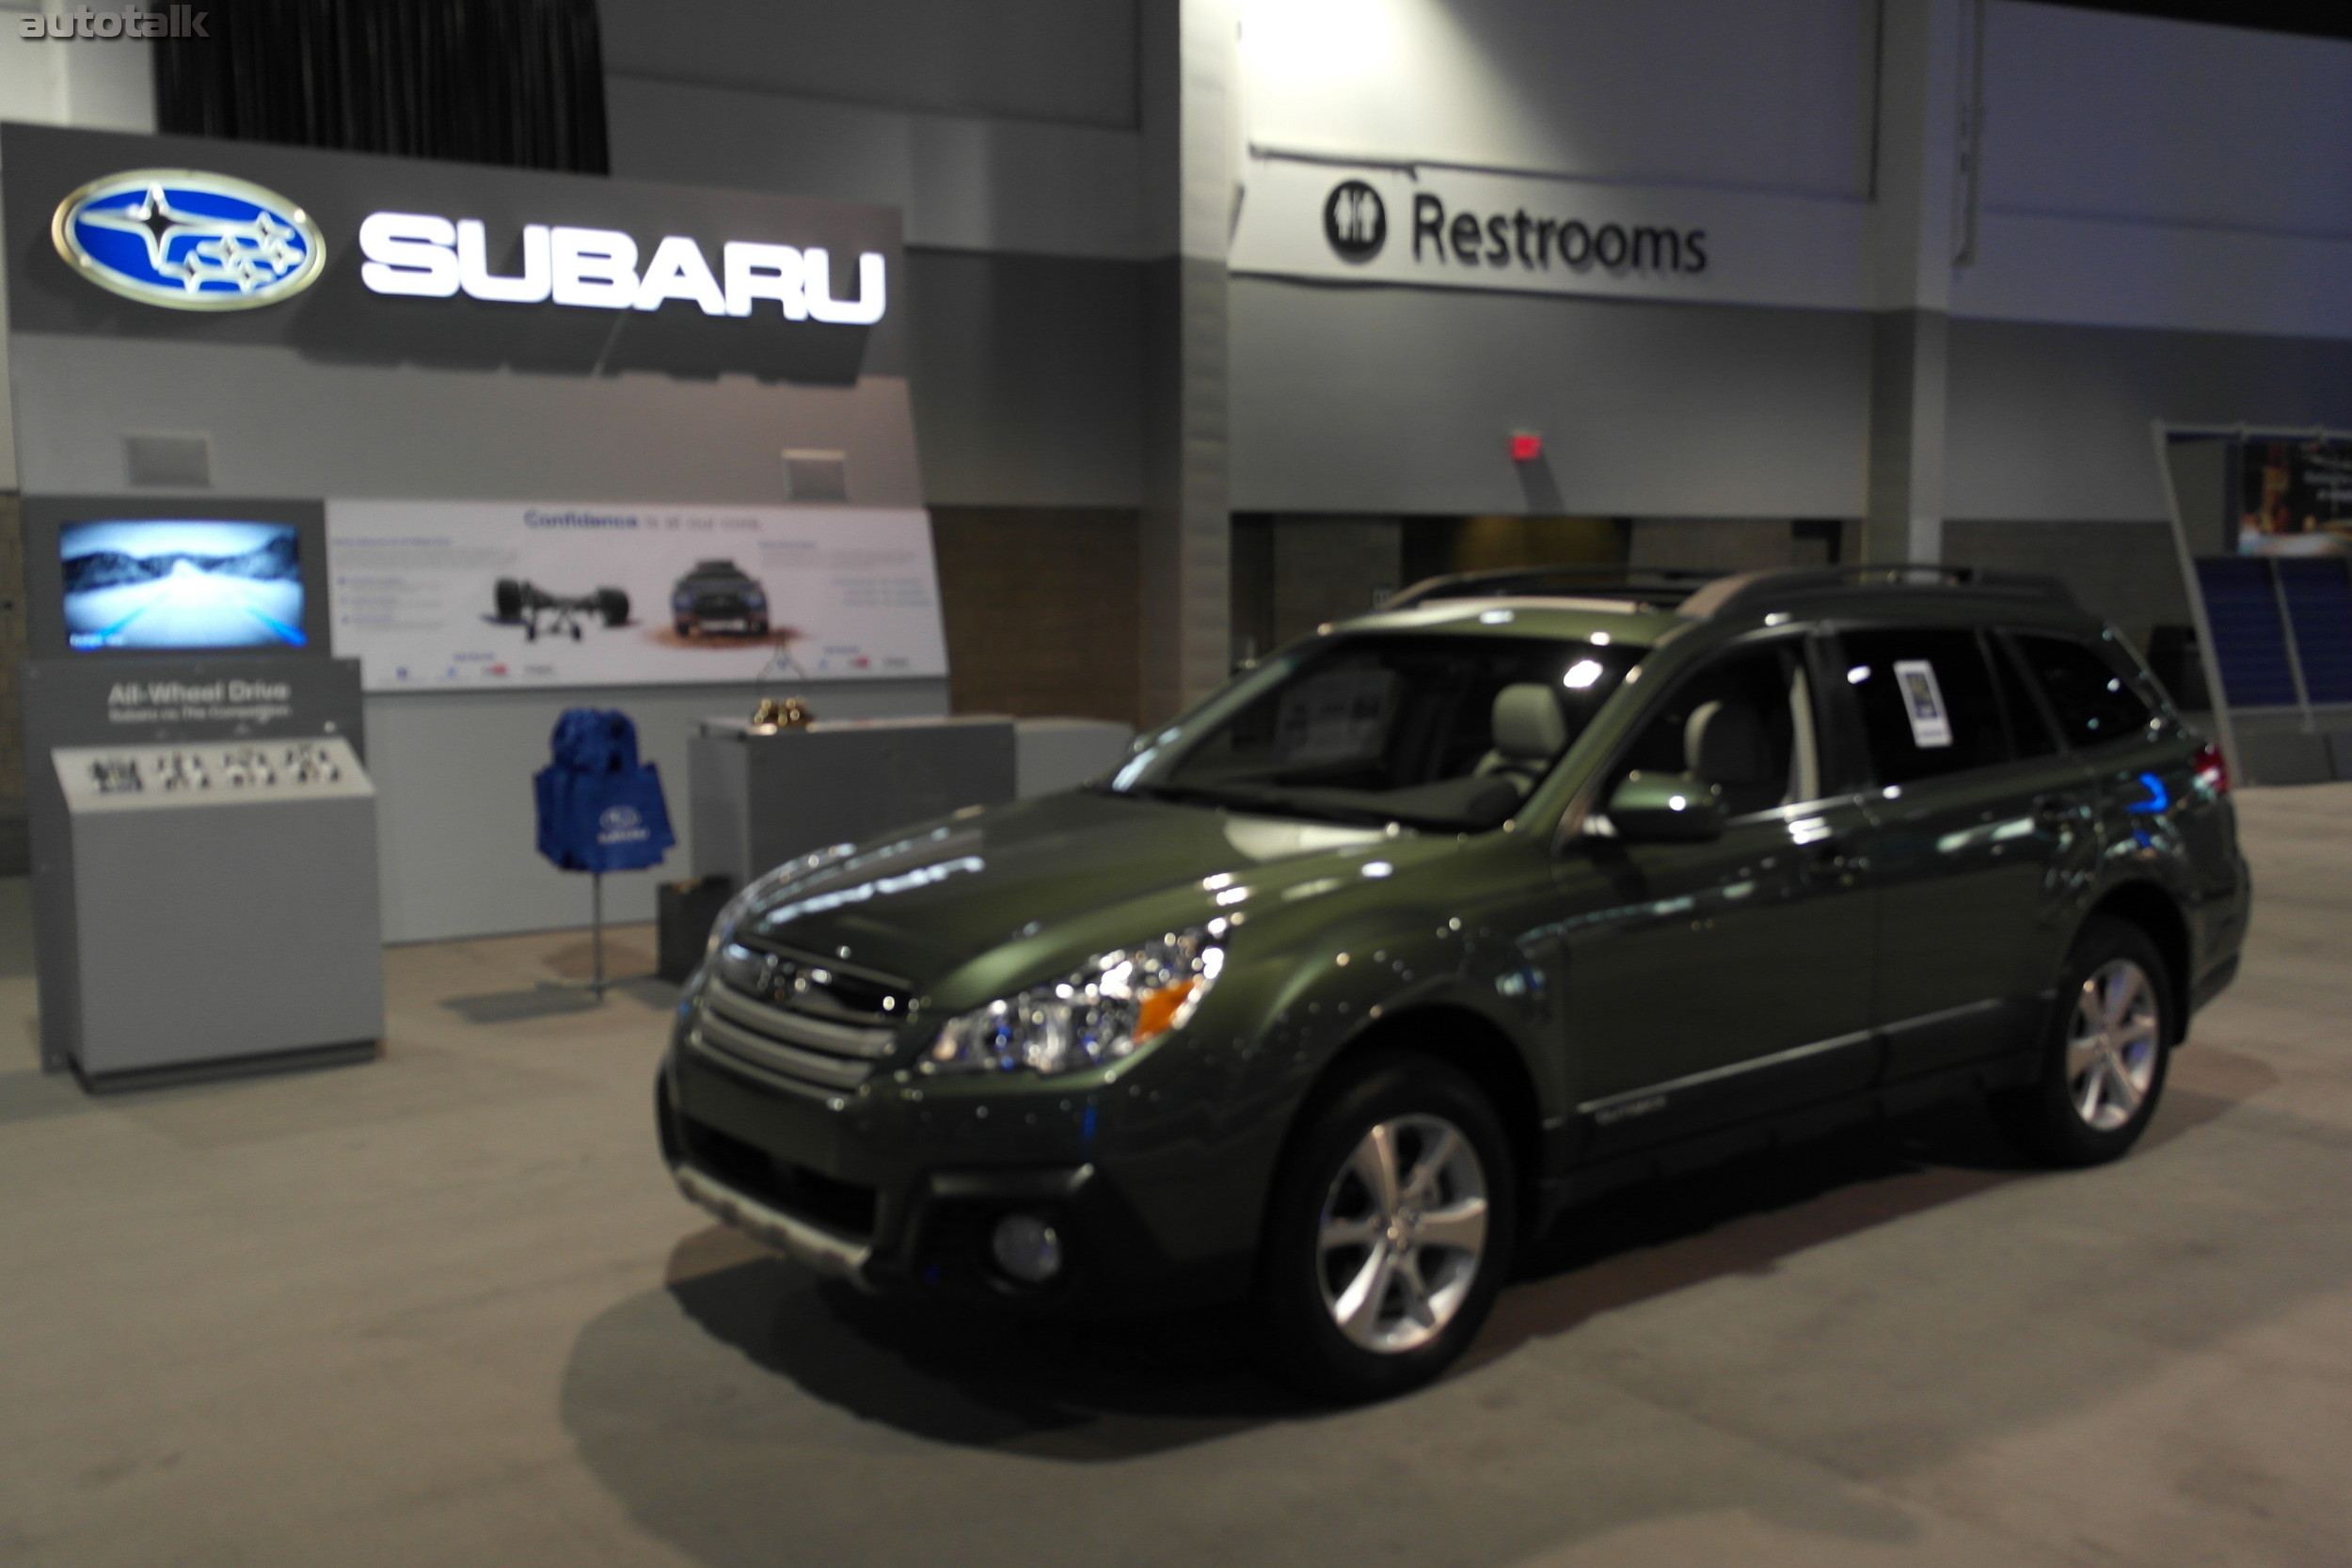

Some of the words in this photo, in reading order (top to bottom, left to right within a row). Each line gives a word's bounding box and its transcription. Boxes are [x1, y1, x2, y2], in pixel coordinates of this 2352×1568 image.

[358, 210, 888, 325] SUBARU
[1414, 193, 1707, 272] Restrooms
[108, 680, 226, 705] All-Wheel
[229, 679, 292, 703] Drive
